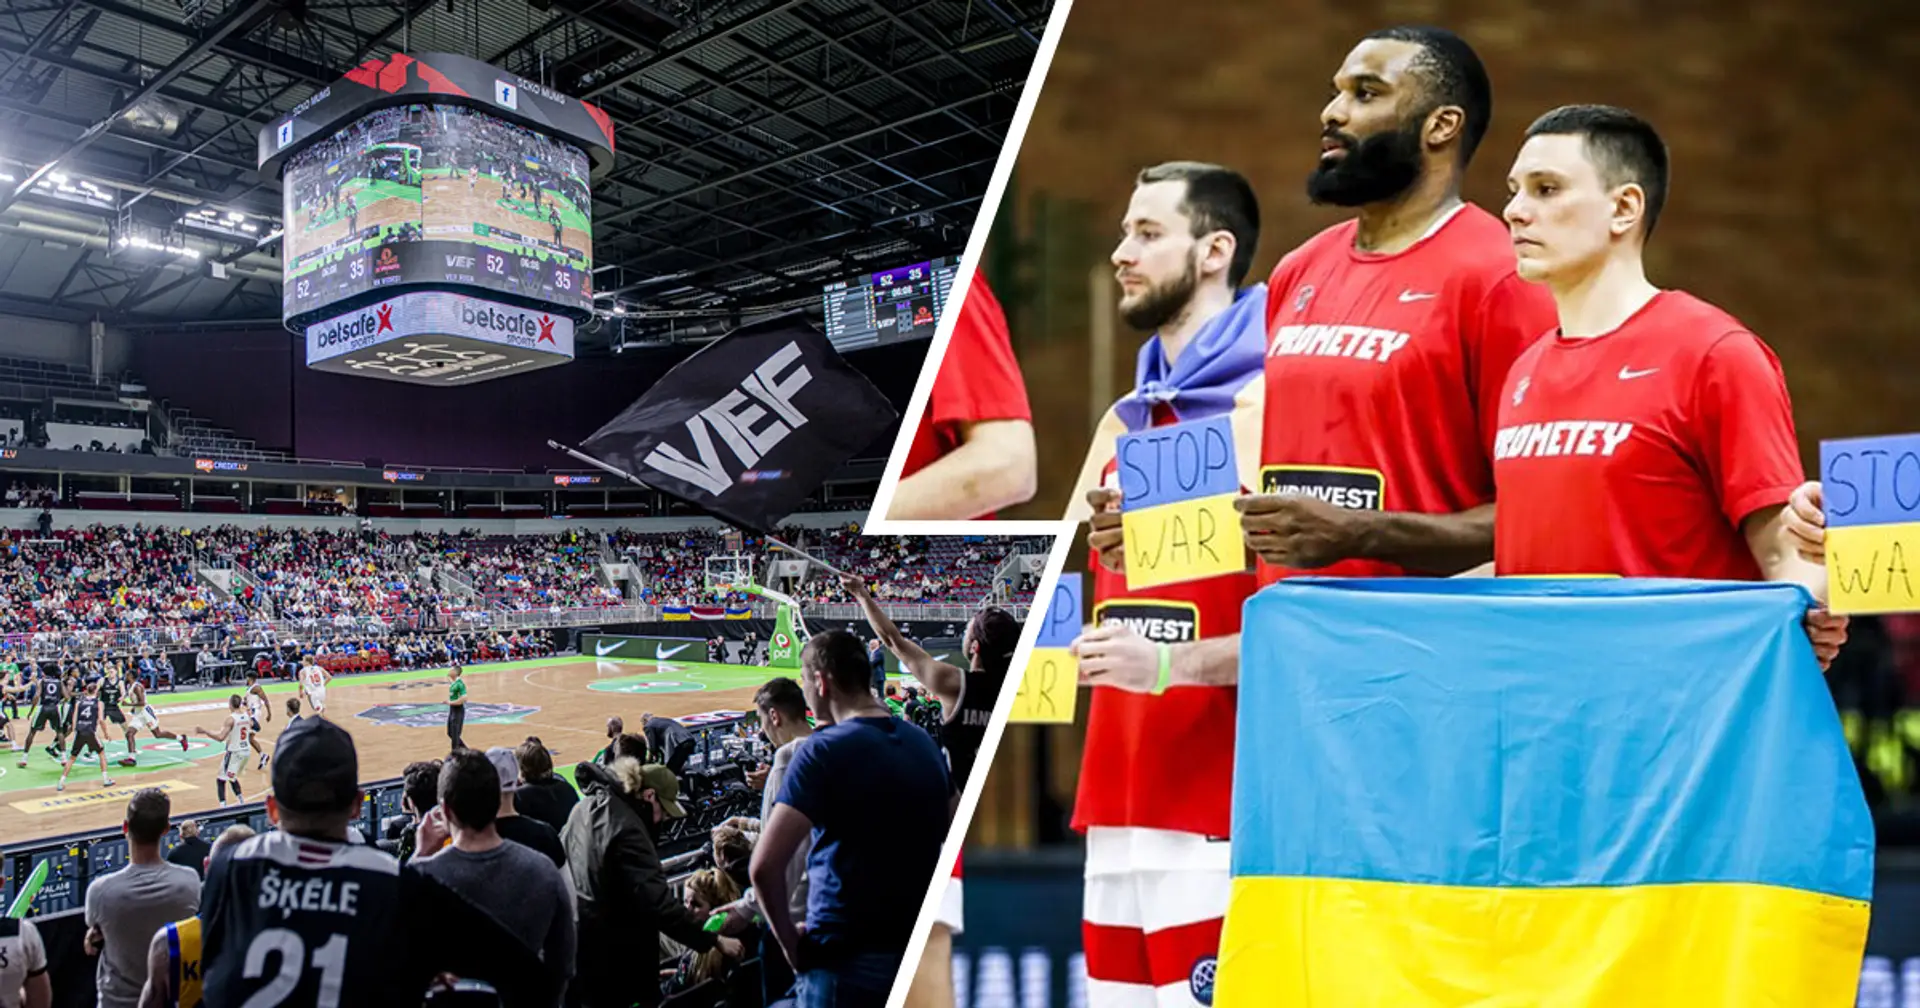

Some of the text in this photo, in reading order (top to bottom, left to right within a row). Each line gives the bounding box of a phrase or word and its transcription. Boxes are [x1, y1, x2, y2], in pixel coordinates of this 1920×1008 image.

[349, 258, 365, 279] 35
[445, 254, 476, 269] VEF
[486, 254, 504, 275] 52
[555, 270, 571, 290] 35
[880, 267, 922, 287] 52 35
[297, 280, 310, 299] 52
[318, 313, 376, 348] betsafe
[462, 303, 537, 337] betsafe
[350, 335, 376, 349] SPORTS
[506, 334, 536, 348] SPORTS
[643, 340, 813, 497] VEF
[1122, 427, 1228, 503] STOP
[1130, 508, 1220, 570] WAR
[1833, 541, 1914, 598] WA
[774, 647, 791, 661] paf
[46, 683, 57, 694] 0
[81, 706, 92, 719] 4
[258, 868, 360, 920] ŠĶĒLE
[240, 928, 349, 1008] 21
